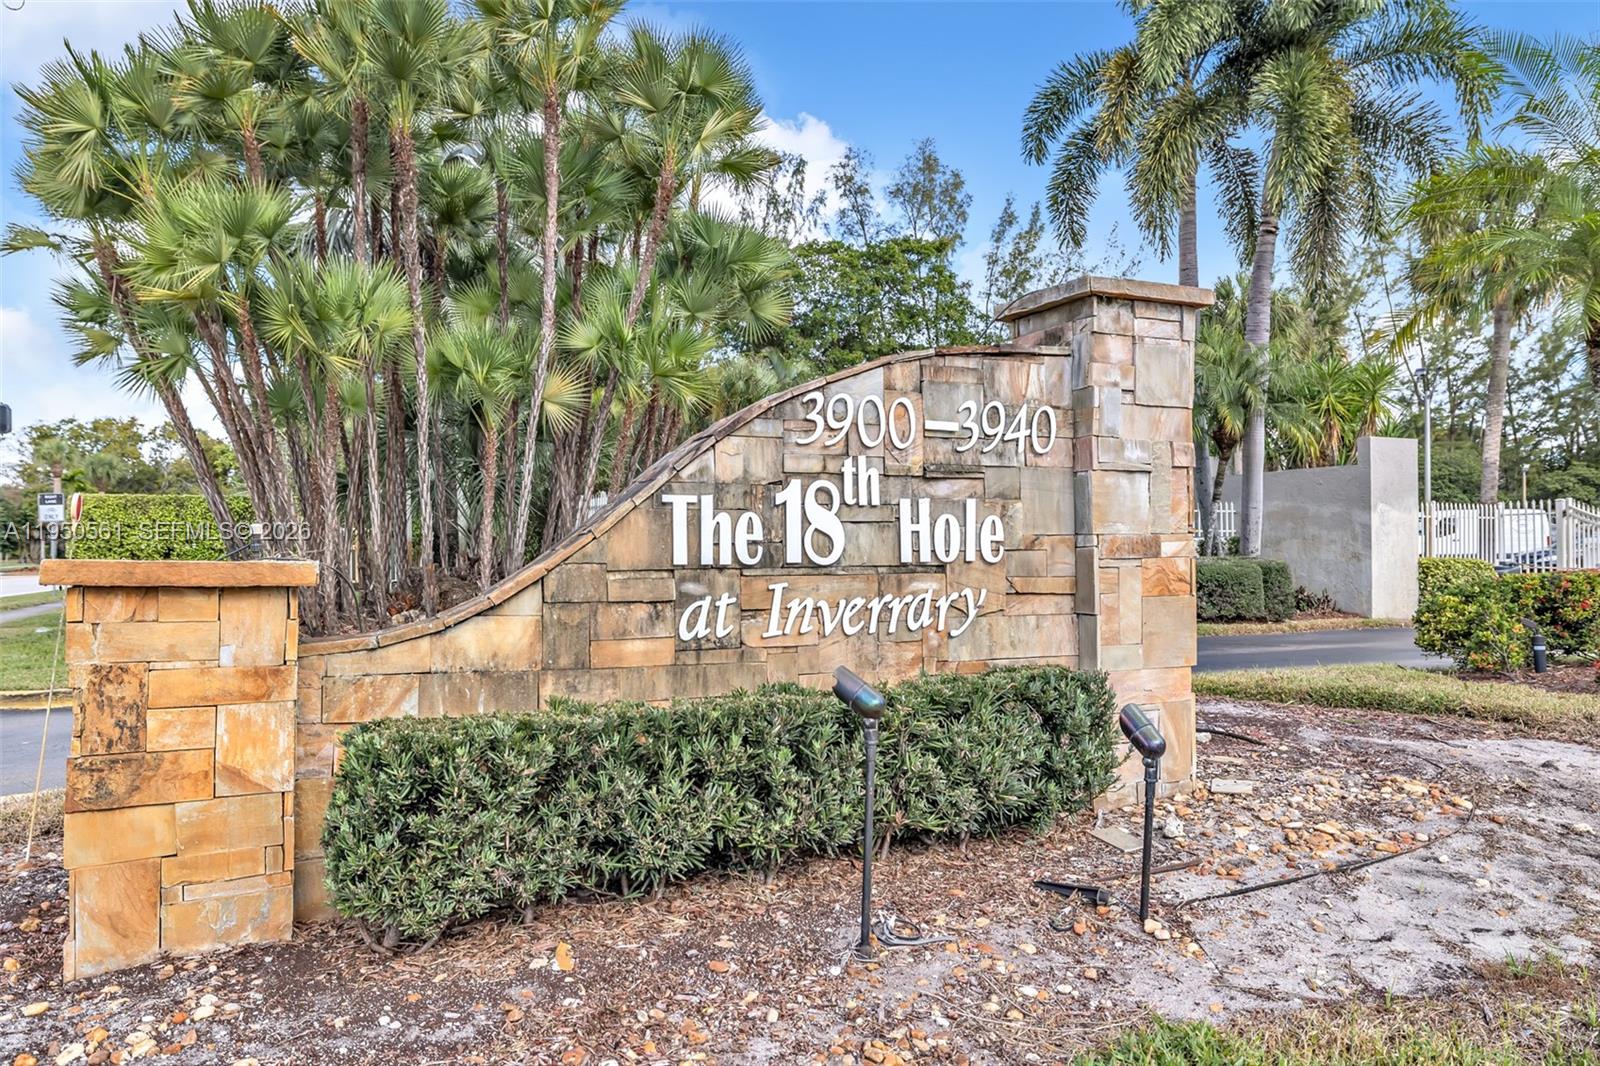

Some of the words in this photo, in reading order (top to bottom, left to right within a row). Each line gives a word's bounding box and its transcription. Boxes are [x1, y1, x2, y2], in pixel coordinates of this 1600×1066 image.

[661, 494, 765, 566] The
[900, 497, 1005, 564] Hole
[678, 591, 737, 642] at
[762, 582, 987, 639] Inverrary
